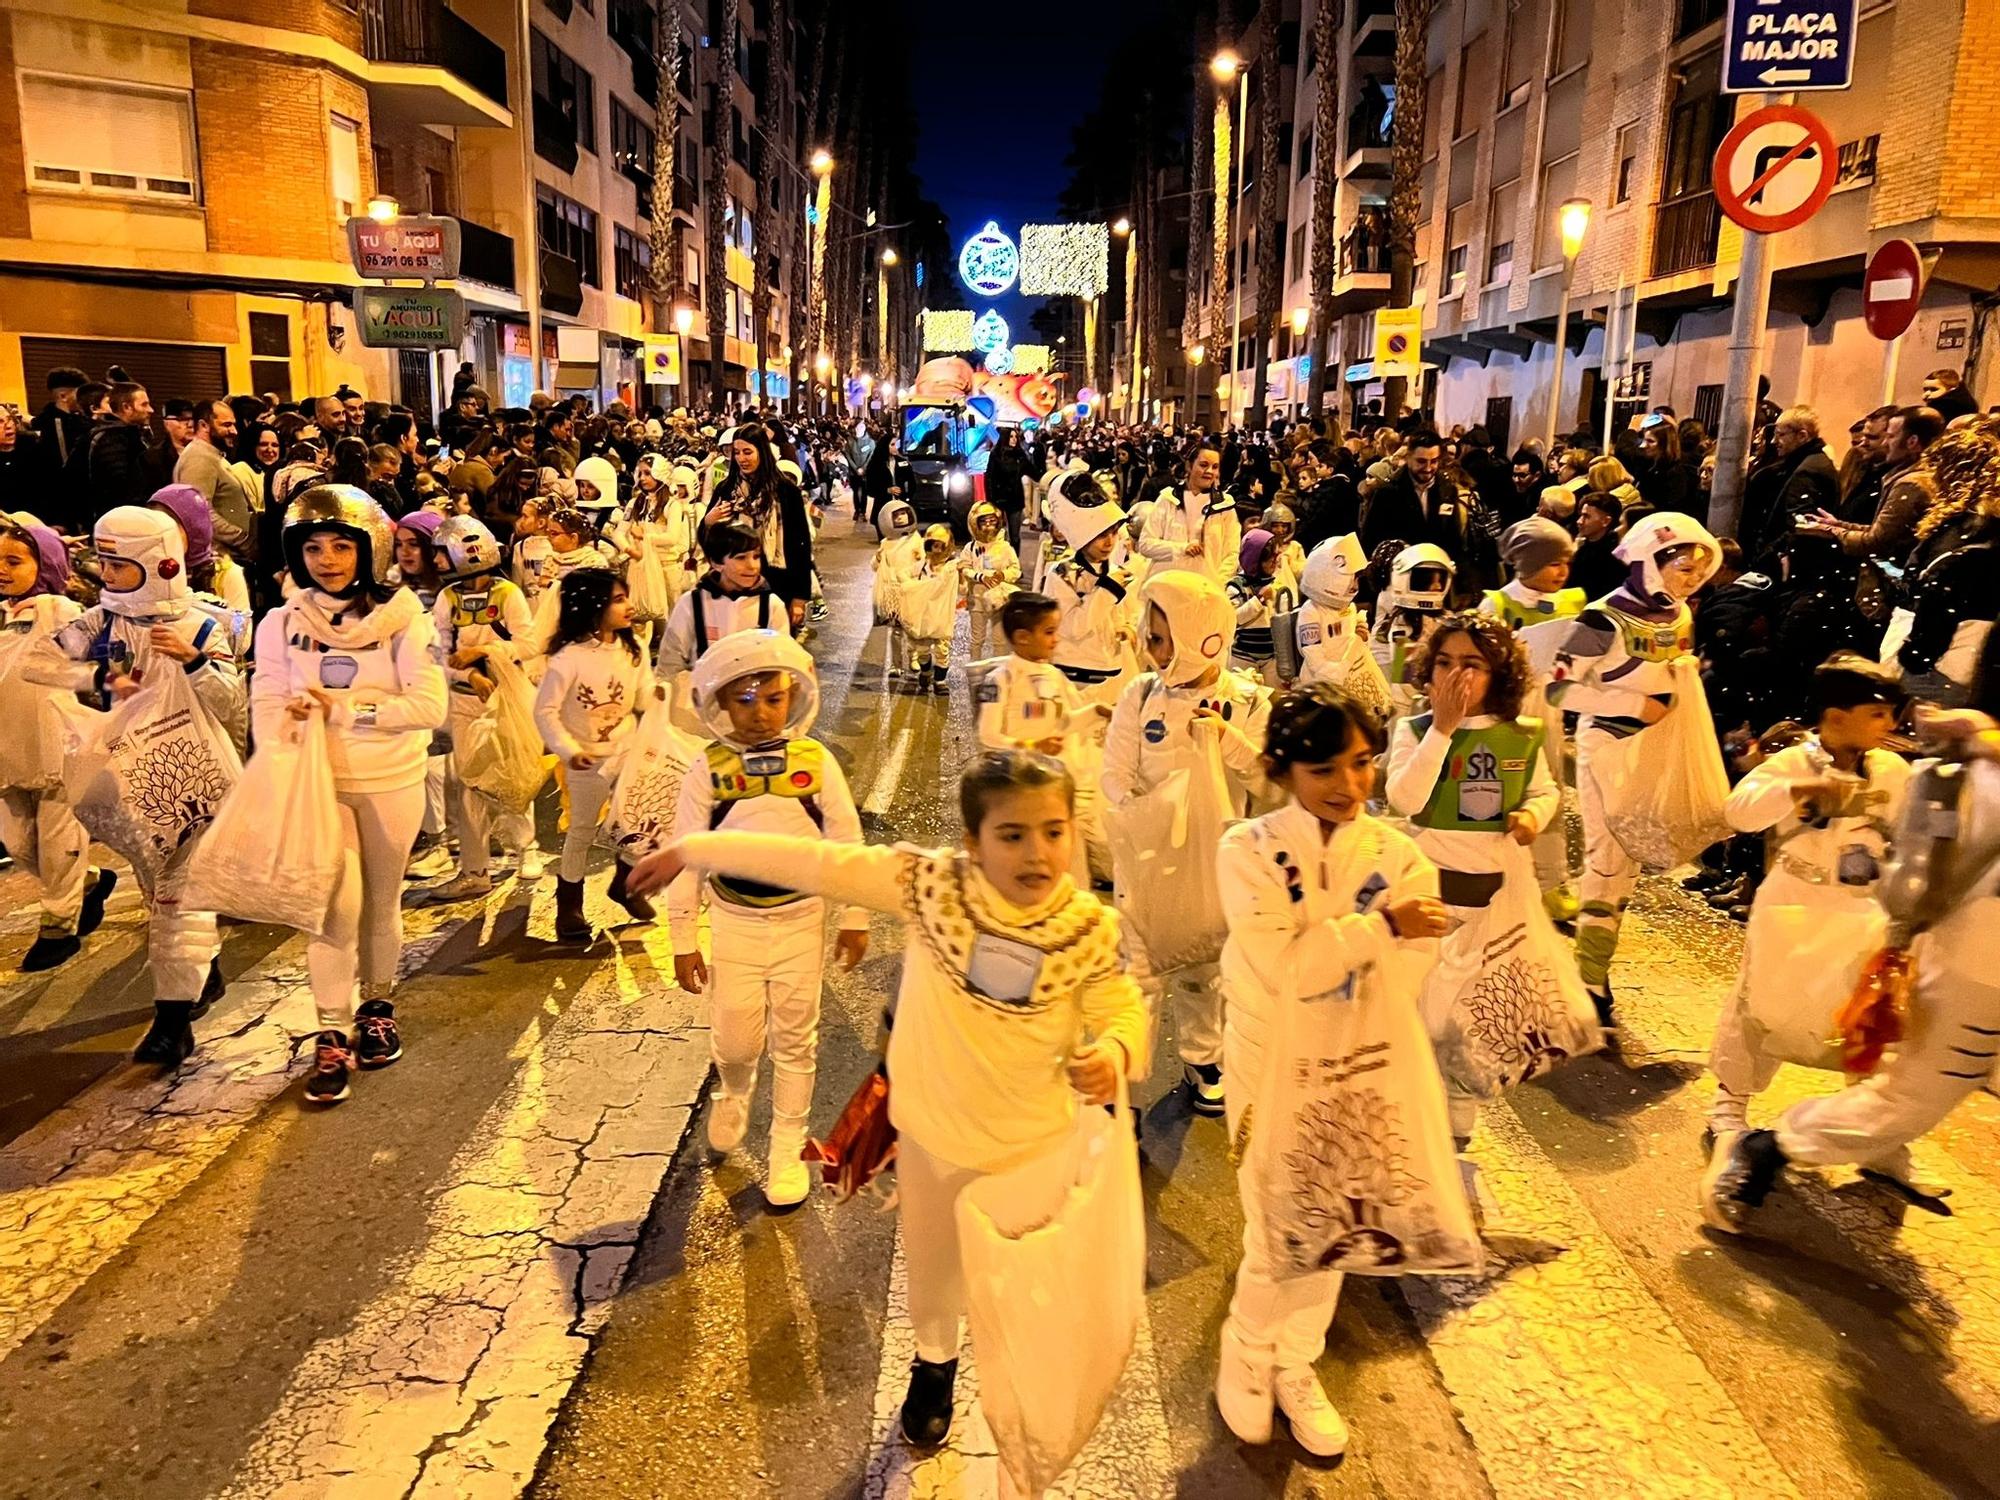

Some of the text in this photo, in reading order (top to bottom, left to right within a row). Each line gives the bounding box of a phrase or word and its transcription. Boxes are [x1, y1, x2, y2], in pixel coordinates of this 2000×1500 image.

[1747, 13, 1838, 38] PLAÇA
[1741, 39, 1839, 60] MAJOR
[360, 235, 379, 248] TU
[365, 255, 378, 266] 96
[1467, 752, 1497, 779] SR
